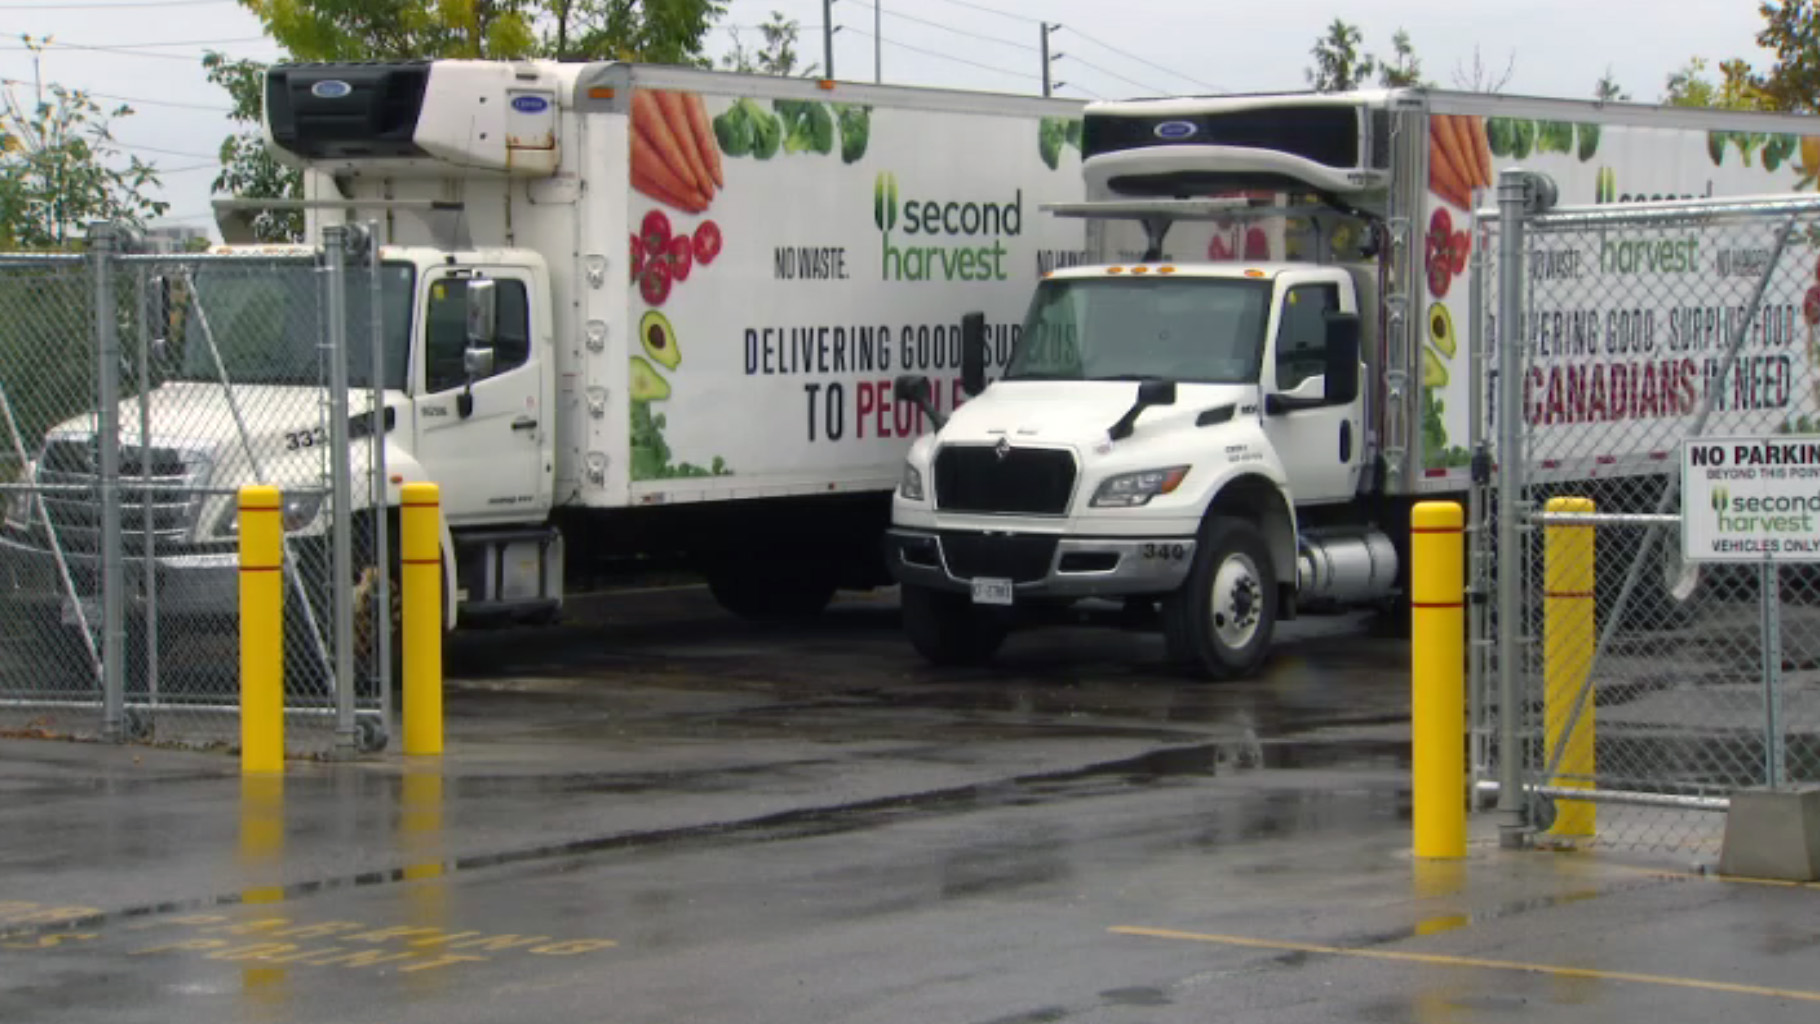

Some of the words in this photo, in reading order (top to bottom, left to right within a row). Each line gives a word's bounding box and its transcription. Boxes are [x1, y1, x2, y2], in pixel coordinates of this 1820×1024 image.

[903, 188, 1021, 236] second
[774, 247, 795, 279] NO
[799, 247, 849, 279] WASTE.
[882, 232, 1007, 281] harvest
[1600, 232, 1699, 273] harvest
[744, 325, 891, 375] DELIVERING
[1522, 358, 1697, 426] CANADIANS
[1734, 354, 1791, 412] NEED
[804, 382, 844, 442] TO
[1691, 445, 1726, 467] NO
[1706, 468, 1757, 480] BEYOND
[1760, 467, 1786, 479] THIS
[1718, 511, 1814, 533] harvest
[1142, 543, 1184, 561] 340
[1711, 539, 1780, 552] VEHICLES
[1783, 538, 1820, 551] ONLY
